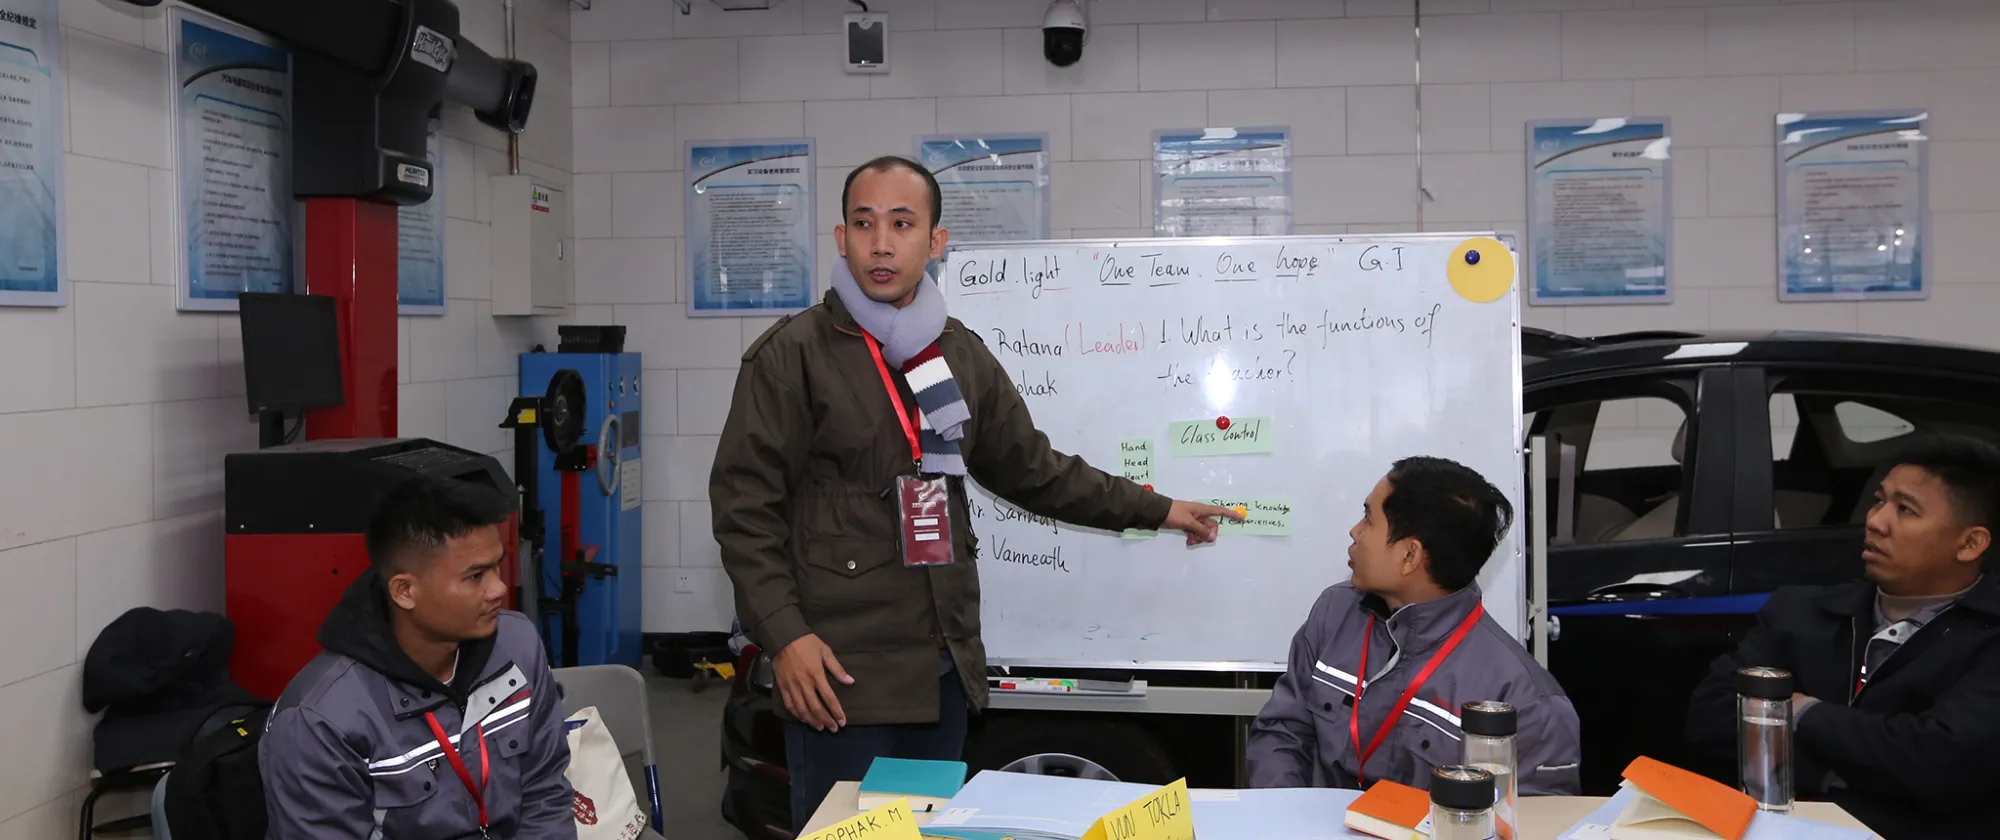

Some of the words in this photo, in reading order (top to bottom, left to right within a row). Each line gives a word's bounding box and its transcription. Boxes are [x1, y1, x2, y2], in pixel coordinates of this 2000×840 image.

[1216, 252, 1257, 275] One
[1180, 314, 1233, 345] What
[1244, 322, 1263, 342] is
[1276, 311, 1308, 340] the
[1316, 307, 1405, 350] functions
[1414, 303, 1441, 349] of
[992, 328, 1062, 357] Ratana
[1157, 363, 1194, 388] the
[1207, 349, 1296, 383] acher?
[1181, 424, 1215, 444] Class
[1223, 419, 1260, 442] Control
[1121, 441, 1147, 452] Hand
[1124, 456, 1148, 467] Head
[1124, 469, 1148, 480] Heart
[992, 534, 1069, 573] Vanneath
[1143, 790, 1181, 828] TOKLA
